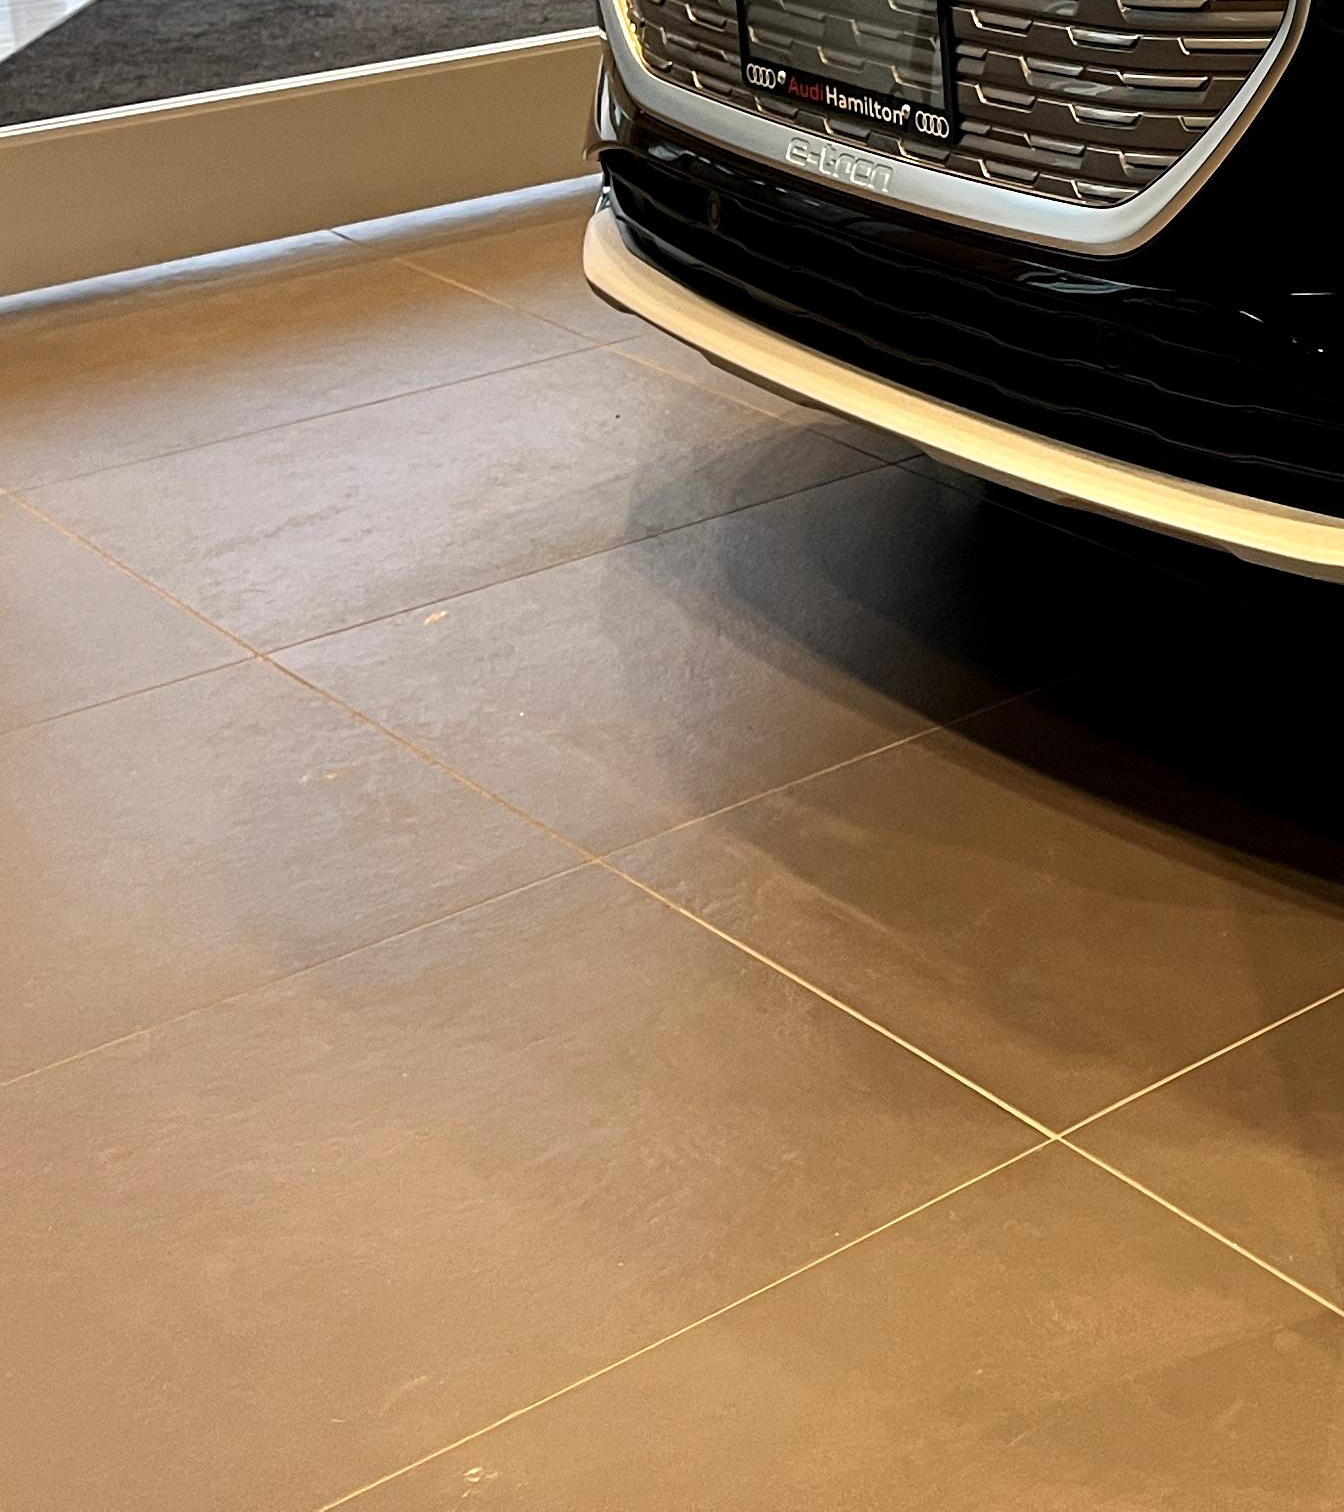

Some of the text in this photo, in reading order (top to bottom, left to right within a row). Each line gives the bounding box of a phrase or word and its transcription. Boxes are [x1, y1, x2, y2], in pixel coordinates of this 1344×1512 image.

[788, 76, 904, 126] Audi Hamilton
[785, 137, 894, 193] e-tron
